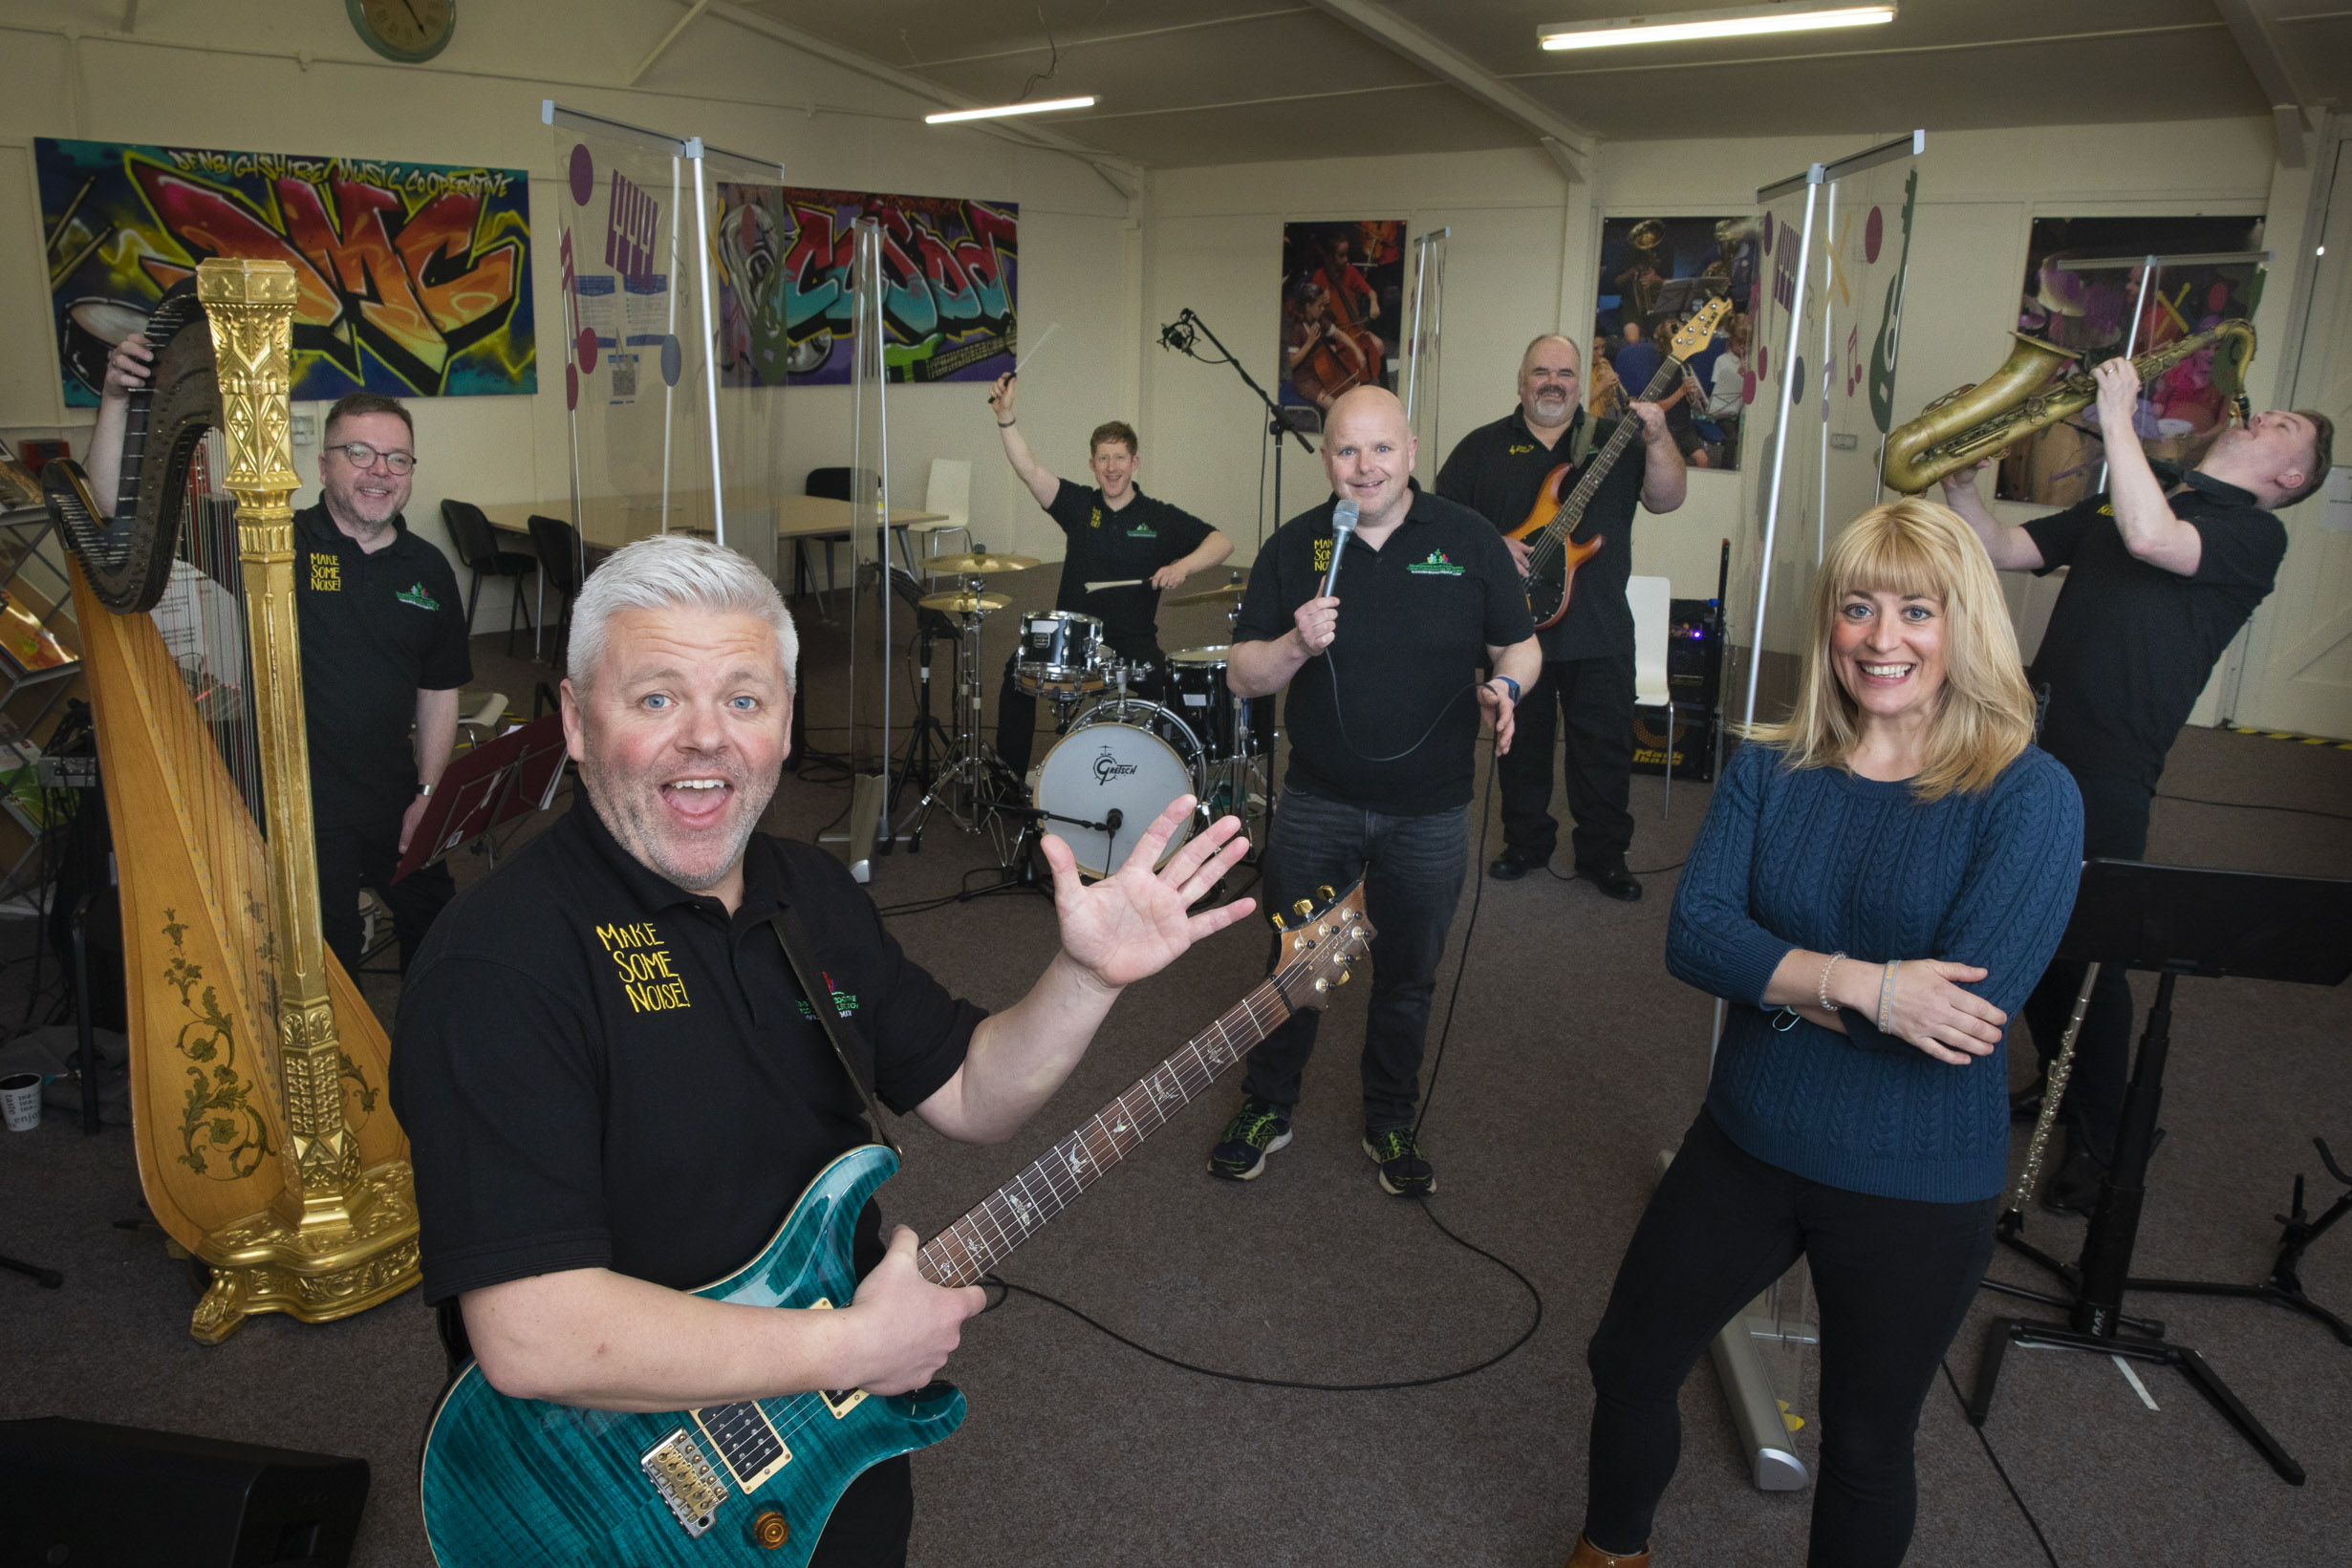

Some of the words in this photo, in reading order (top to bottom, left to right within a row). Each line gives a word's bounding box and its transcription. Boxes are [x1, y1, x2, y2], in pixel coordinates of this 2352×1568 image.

[1314, 538, 1333, 549] MAK
[310, 552, 340, 566] MAKE
[311, 565, 340, 579] SOME
[311, 578, 341, 591] NOISE!
[595, 922, 665, 951] MAKE
[613, 950, 680, 983] SOME
[625, 976, 691, 1013] NOISE!
